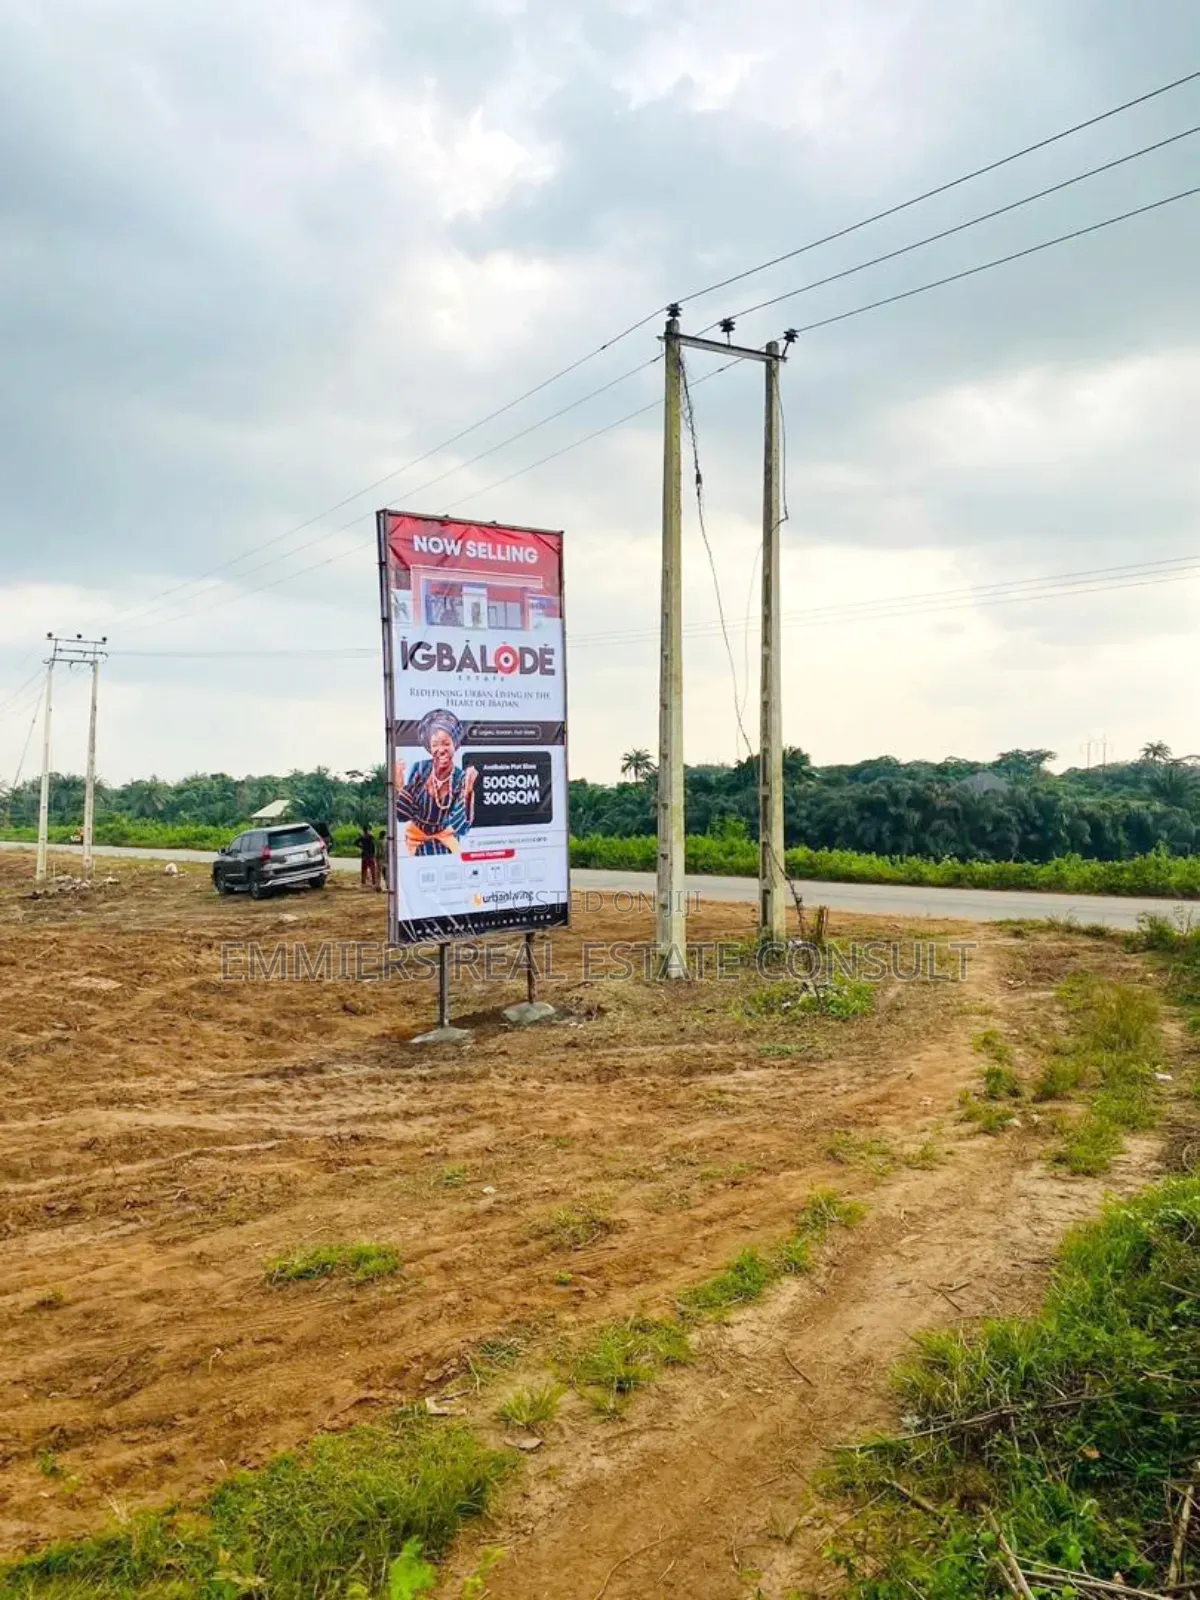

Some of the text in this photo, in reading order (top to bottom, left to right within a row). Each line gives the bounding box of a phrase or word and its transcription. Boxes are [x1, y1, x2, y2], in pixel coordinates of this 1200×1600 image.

[412, 534, 539, 564] NOW SELLING
[483, 774, 540, 790] 500SQM
[483, 790, 540, 805] 300SQM
